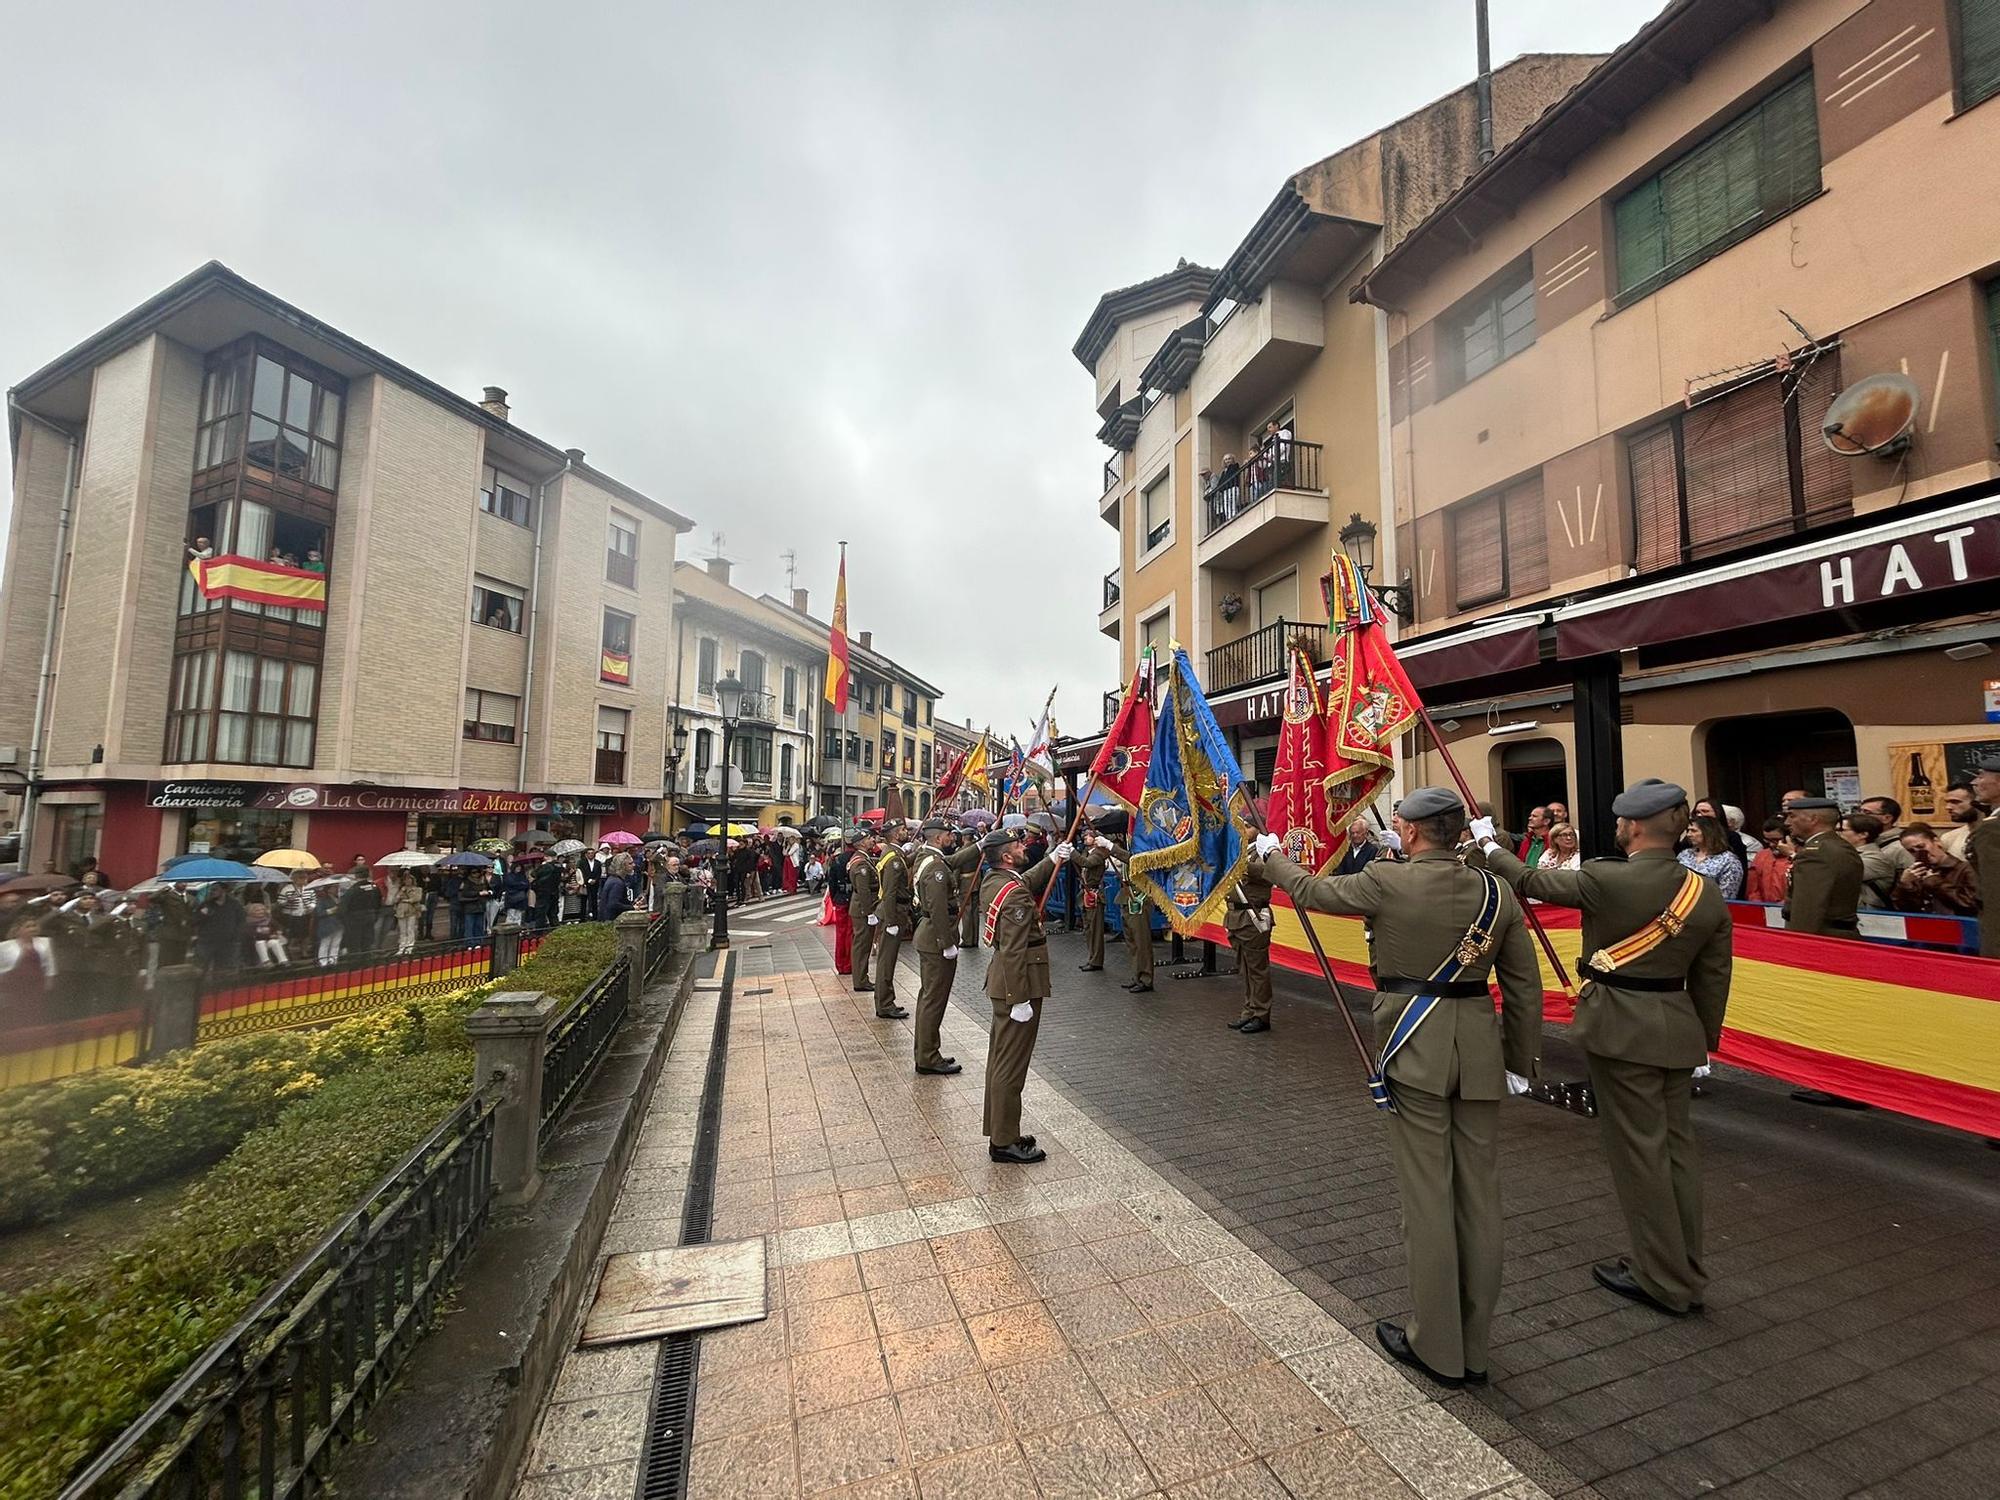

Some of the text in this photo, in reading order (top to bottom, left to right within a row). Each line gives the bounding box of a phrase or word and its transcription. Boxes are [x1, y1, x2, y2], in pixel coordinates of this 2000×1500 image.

[322, 790, 351, 808] La
[357, 791, 458, 810] Carnicería
[463, 794, 479, 810] de
[483, 795, 528, 812] Marco
